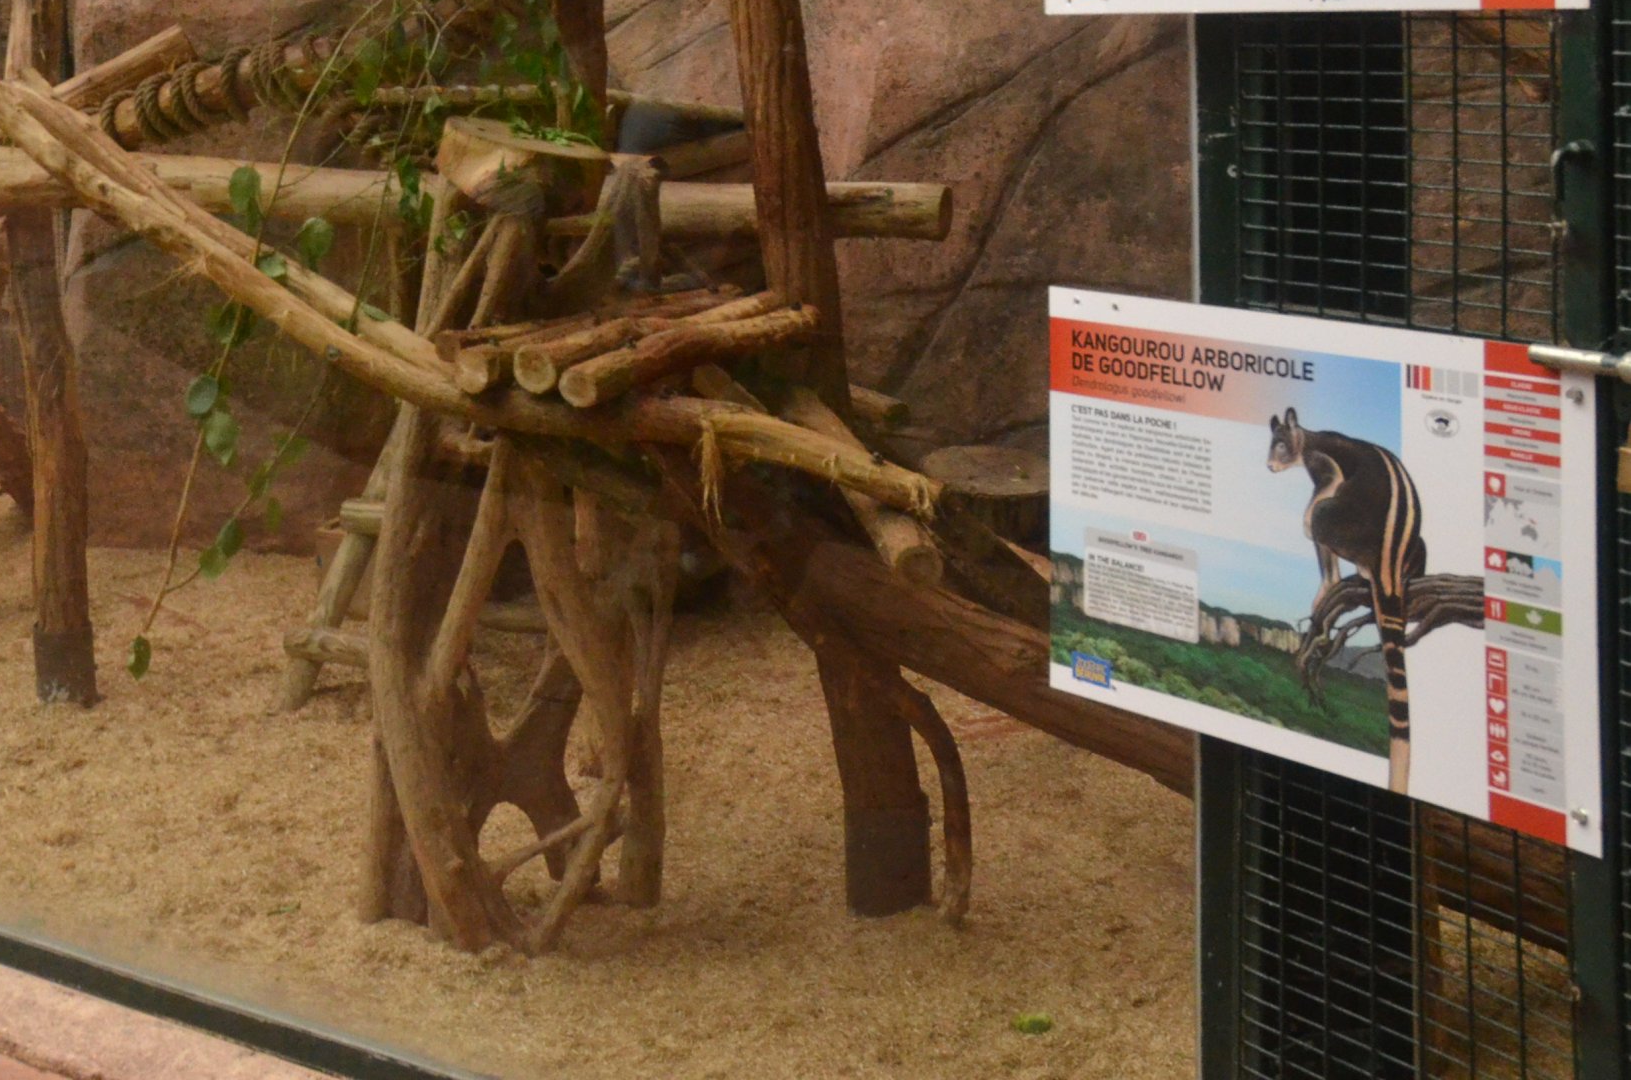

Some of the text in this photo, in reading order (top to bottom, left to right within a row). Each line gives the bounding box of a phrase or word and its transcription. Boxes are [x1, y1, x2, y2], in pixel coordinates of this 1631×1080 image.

[1071, 329, 1315, 382] KANGOUROU ARBORICOLE
[1072, 352, 1226, 392] DE GOODFELLOW
[1071, 404, 1092, 416] C'EST
[1094, 408, 1109, 418] PAS
[1110, 411, 1131, 422] DANS
[1133, 414, 1144, 424] LA
[1145, 417, 1171, 429] POCHE
